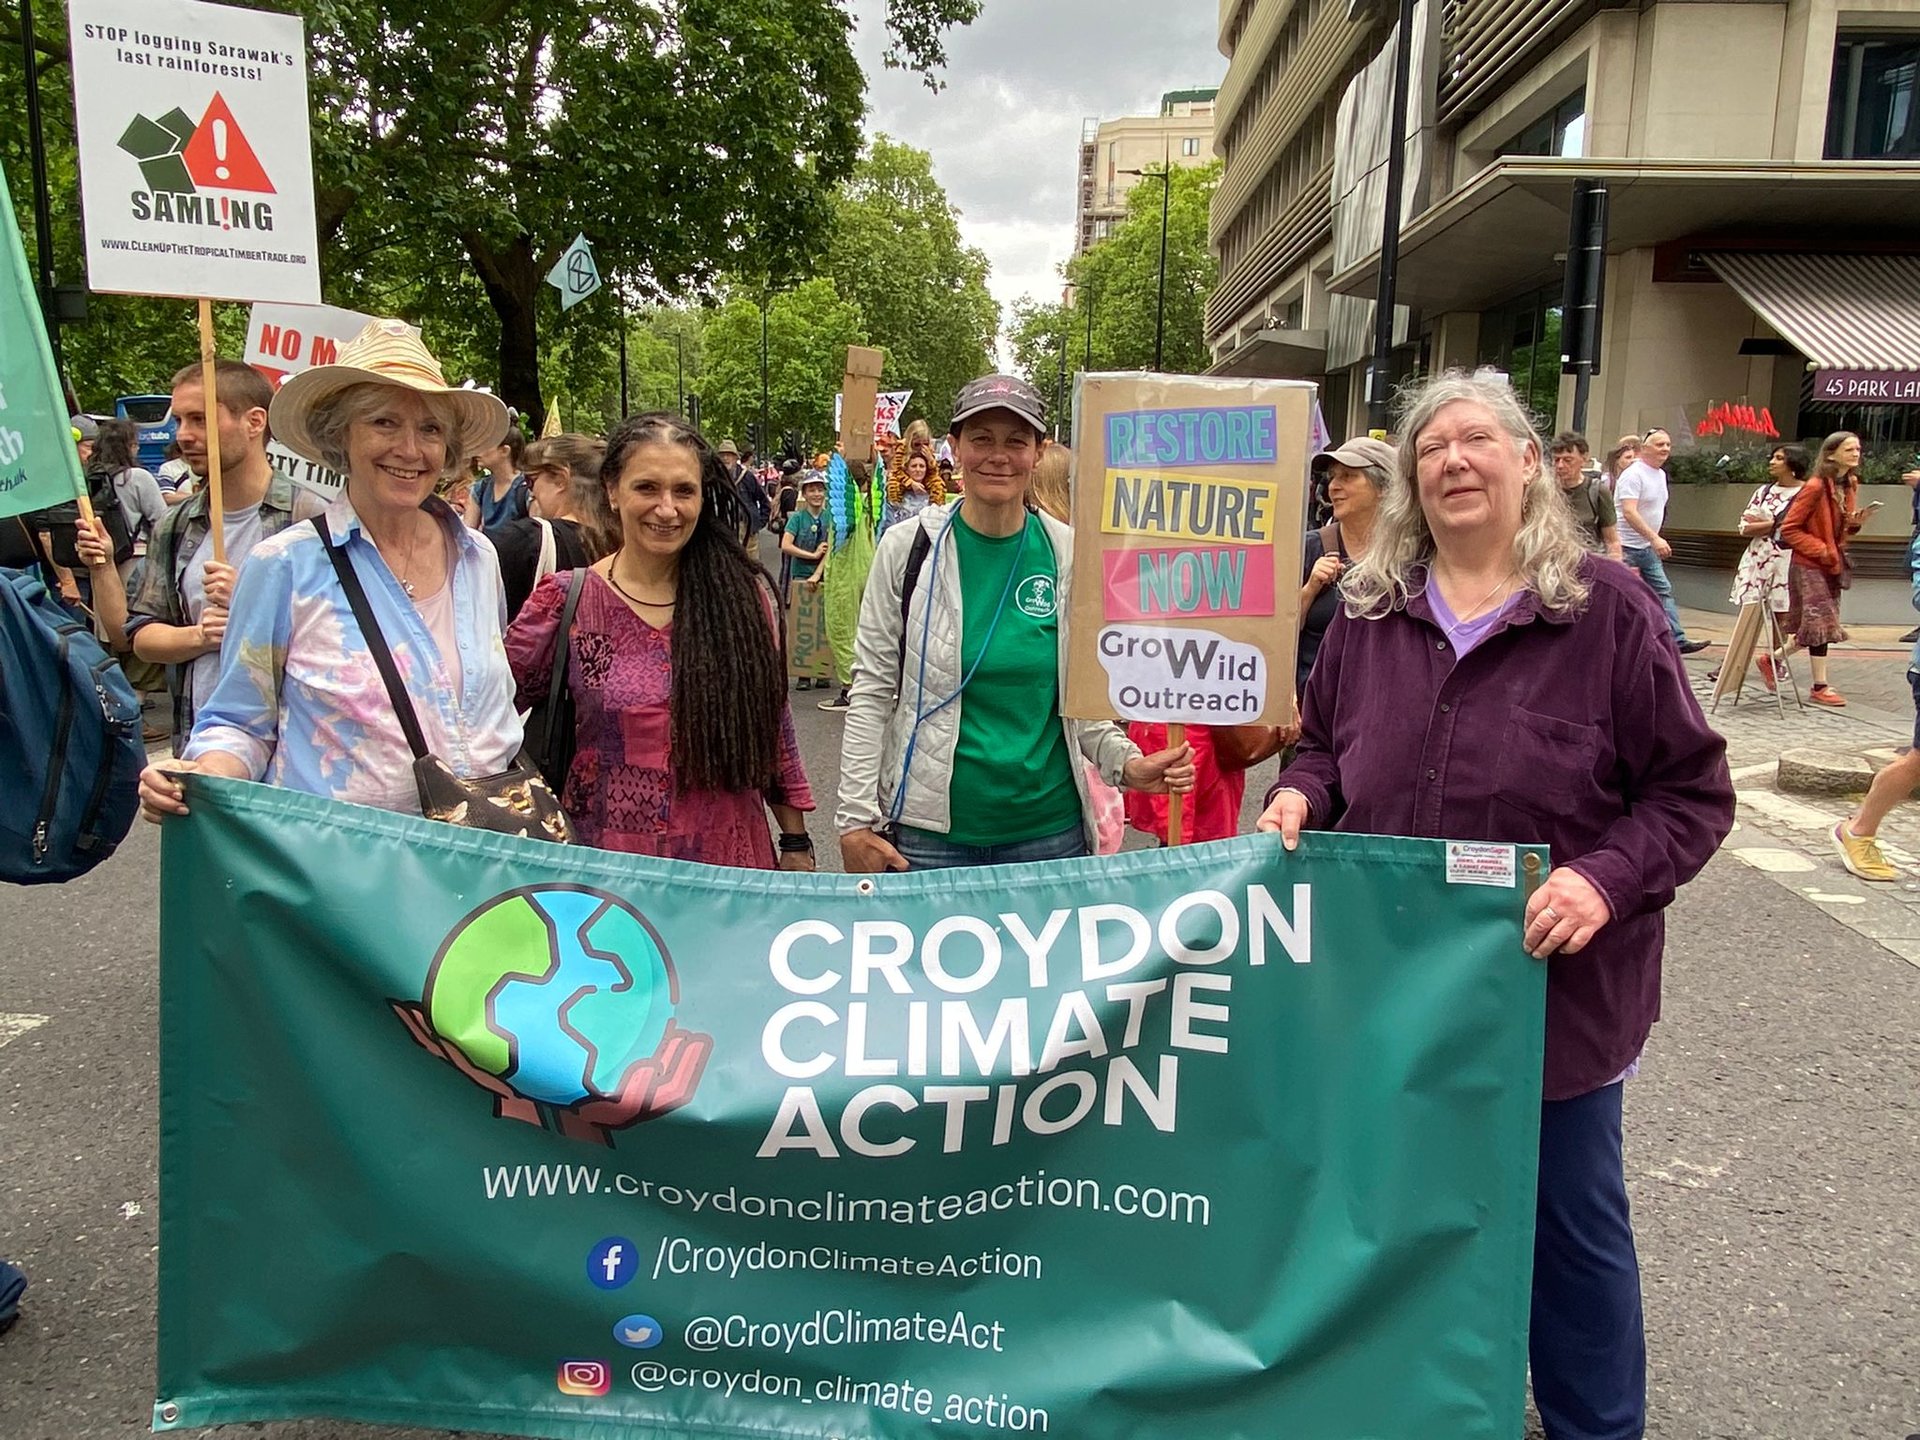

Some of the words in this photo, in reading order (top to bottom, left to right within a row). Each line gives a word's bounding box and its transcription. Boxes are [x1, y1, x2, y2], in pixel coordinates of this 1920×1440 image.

[85, 24, 128, 42] STOP
[134, 30, 201, 54] logging
[208, 41, 293, 66] Sarawak's
[117, 48, 152, 66] last
[157, 55, 262, 81] rainforests!
[260, 323, 301, 361] NO
[309, 335, 337, 366] M
[1825, 378, 1844, 396] 45
[1848, 379, 1889, 397] PARK
[1109, 409, 1274, 465] RESTORE
[266, 452, 299, 477] RTY
[1112, 477, 1269, 540] NATURE
[1138, 550, 1248, 613] NOW
[1118, 685, 1258, 713] Outreach
[768, 883, 1311, 995] CROYDON
[761, 972, 1232, 1078] CLIMATE
[755, 1054, 1179, 1158] ACTION
[652, 1236, 1043, 1280] /CroydonClimateAction
[684, 1308, 1006, 1354] @CroydClimateAct
[631, 1361, 1049, 1432] @croydon_climate_action
